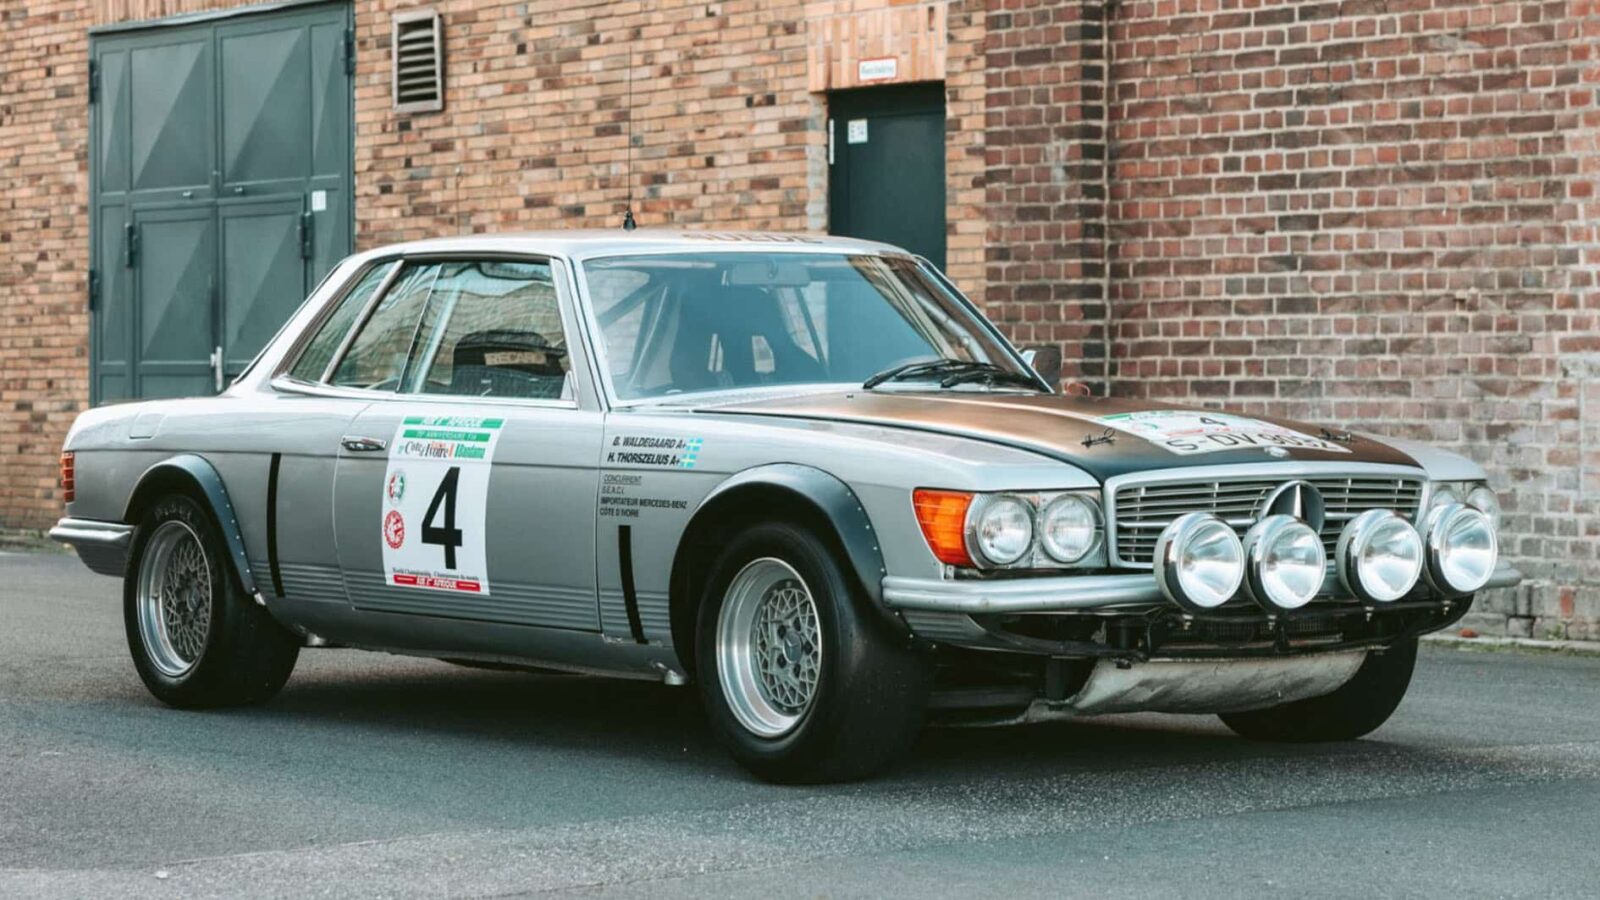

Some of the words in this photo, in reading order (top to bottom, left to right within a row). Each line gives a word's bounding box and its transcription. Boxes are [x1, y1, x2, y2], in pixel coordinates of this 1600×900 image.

[1200, 416, 1227, 426] 4
[622, 436, 676, 449] WALDEGAARD
[607, 452, 615, 462] H.
[617, 452, 670, 465] THORSZELIUS
[669, 455, 680, 466] A+
[639, 498, 688, 509] MERCEDES-BENZ
[421, 466, 462, 570] 4
